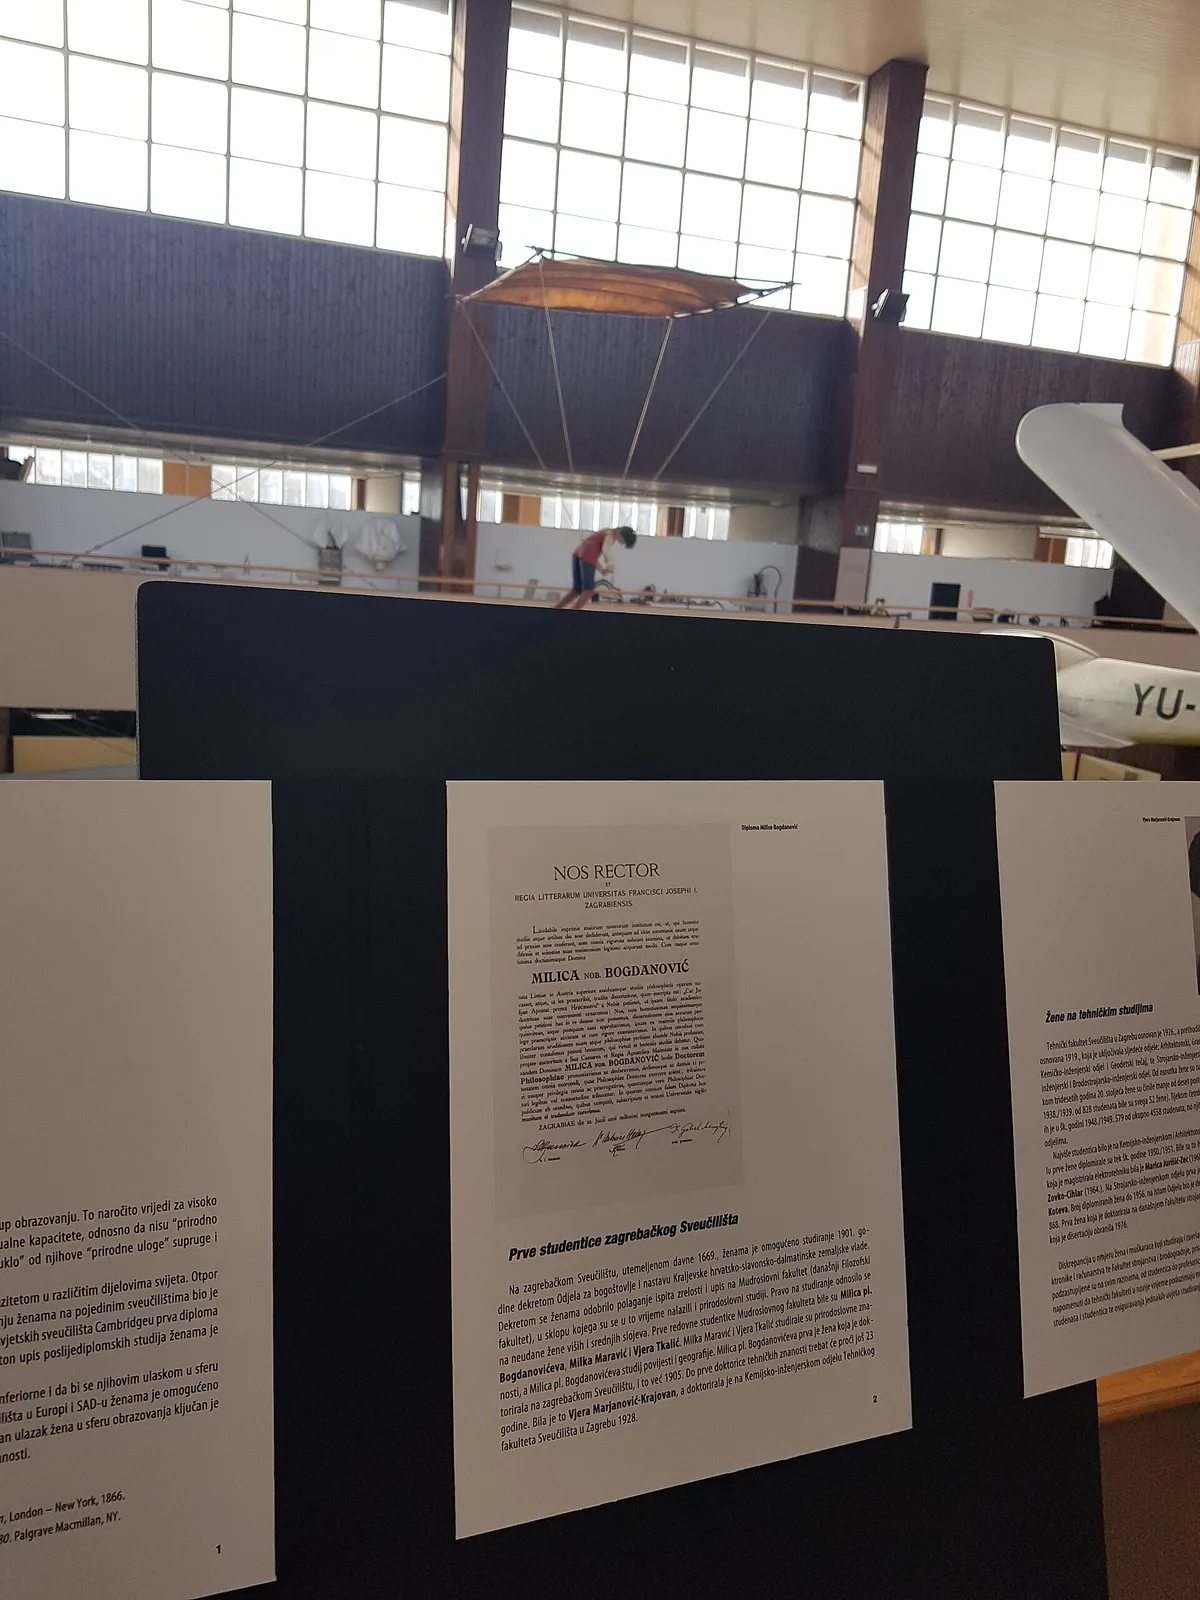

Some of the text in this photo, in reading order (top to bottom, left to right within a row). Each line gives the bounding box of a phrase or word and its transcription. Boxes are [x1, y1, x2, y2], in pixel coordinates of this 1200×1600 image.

[1133, 683, 1196, 720] YU-
[553, 862, 660, 881] NOS RECTOR
[514, 893, 535, 902] REGIA
[538, 891, 580, 901] LITTERARUM
[582, 889, 626, 899] UNIVERSITAS
[628, 888, 663, 897] FRANCISCI
[665, 887, 691, 895] JOSEPHI
[531, 958, 689, 985] MILICA NOB. BOGDANOVIĆ
[1045, 1003, 1153, 1024] Žene na tehničkim studijima
[564, 1062, 593, 1072] MILICA
[14, 1211, 79, 1229] obrazovanju.
[83, 1209, 94, 1222] To
[97, 1204, 137, 1220] naročito
[140, 1199, 170, 1216] vrijedi
[173, 1200, 184, 1211] za
[187, 1194, 216, 1209] visoko
[28, 1252, 41, 1266] od
[45, 1250, 82, 1266] njihove
[172, 1234, 210, 1250] supruge
[214, 1231, 217, 1243] i
[29, 1231, 84, 1249] kapacitete,
[88, 1225, 130, 1240] odnosno
[133, 1221, 145, 1234] da
[149, 1219, 168, 1232] nisu
[508, 1213, 738, 1262] Prve studentice zagrebačkog Sveučilišta
[497, 1303, 515, 1315] dine
[517, 1297, 554, 1312] dekretom
[556, 1290, 580, 1305] Odjela
[582, 1290, 591, 1300] za
[593, 1280, 636, 1299] bogoštovlje
[638, 1279, 640, 1290] i
[643, 1276, 670, 1289] nastavu
[672, 1268, 707, 1284] Kraljevske
[817, 1243, 849, 1258] zemaljske
[850, 1240, 869, 1252] vlade.
[509, 1227, 869, 1296] Na zagrebačkom Sveučilištu, utemeljenom davne 1669., ženama je omogućeno studiranje 1901. go-
[0, 1270, 218, 1308] zitetom u različitim dijelovima svijeta. Otpor
[0, 1307, 217, 1349] vjetskih sveučilišta Cambridgeu prva diploma
[499, 1284, 872, 1367] na neudane žene viših i srednjih slojeva. Prve redovne studentice Mudroslovnog fakulteta bile su Milica pl.
[26, 1380, 218, 1420] u Europi i SAD-u ženama je omogućeno
[500, 1346, 875, 1438] godine. Bila je to Vjera Marjanović-Krajovan, a doktorirala je na Kemijsko-inženjerskom odjelu Tehničkog
[872, 1394, 878, 1405] 2
[500, 1412, 638, 1452] fakulteta Sveučilišta u Zagrebu 1928.
[9, 1490, 125, 1523] London New York, 1866.
[14, 1510, 120, 1542] Palgrave Macmillan, NY.
[214, 1544, 222, 1554] 1
